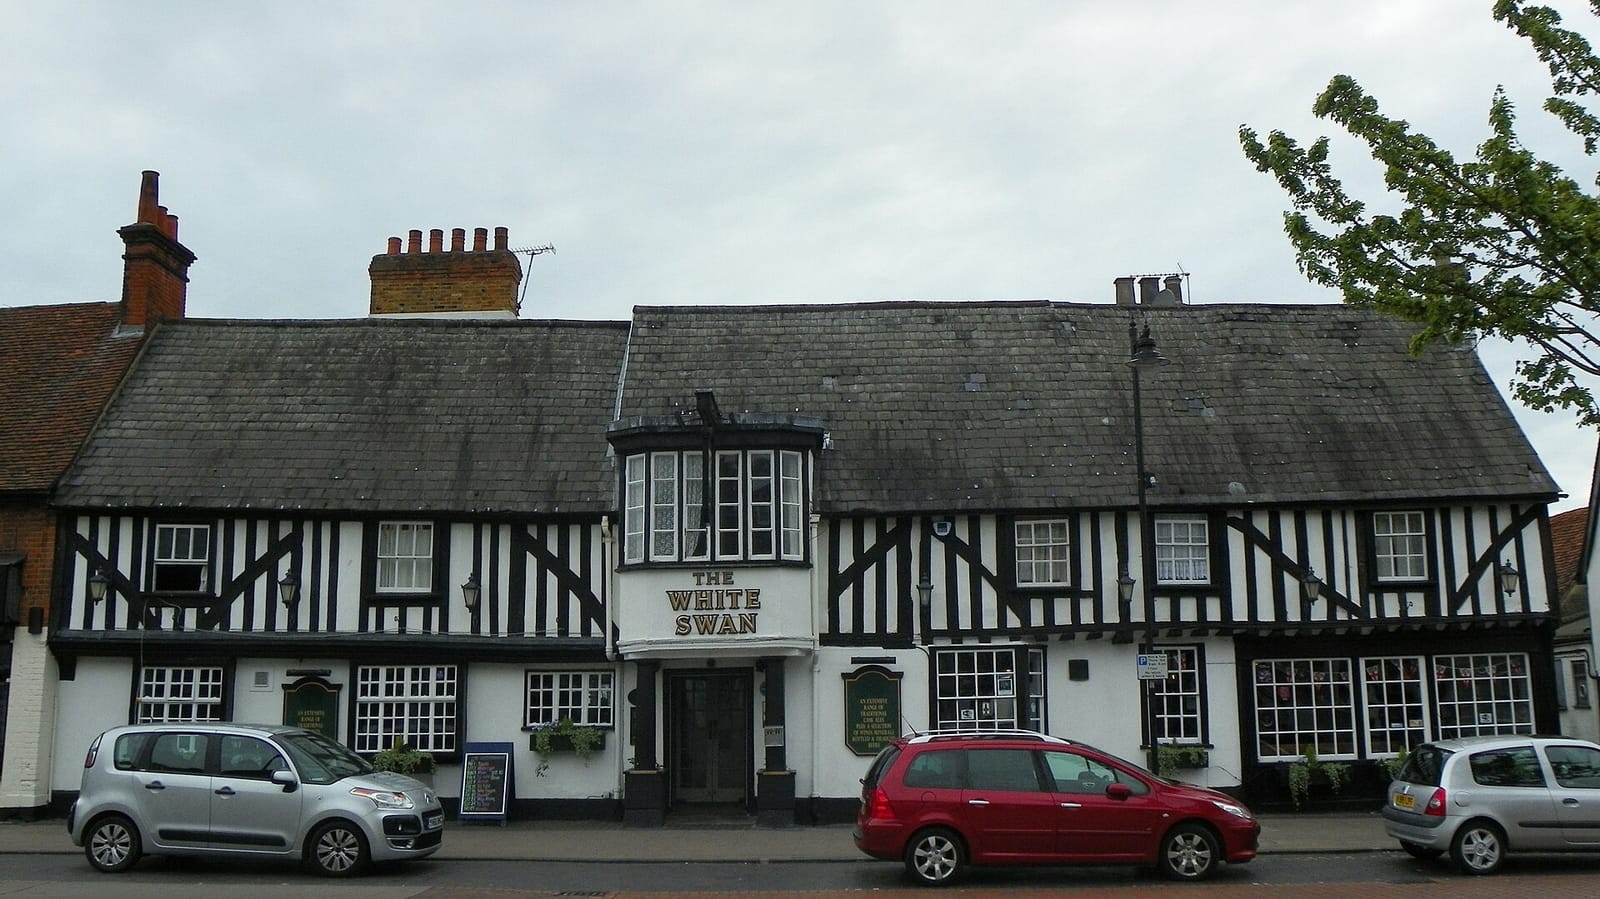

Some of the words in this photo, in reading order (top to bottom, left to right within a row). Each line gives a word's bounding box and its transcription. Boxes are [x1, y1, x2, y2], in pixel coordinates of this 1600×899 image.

[692, 571, 734, 586] THE
[666, 588, 761, 611] WHITE
[675, 613, 758, 636] SWAN
